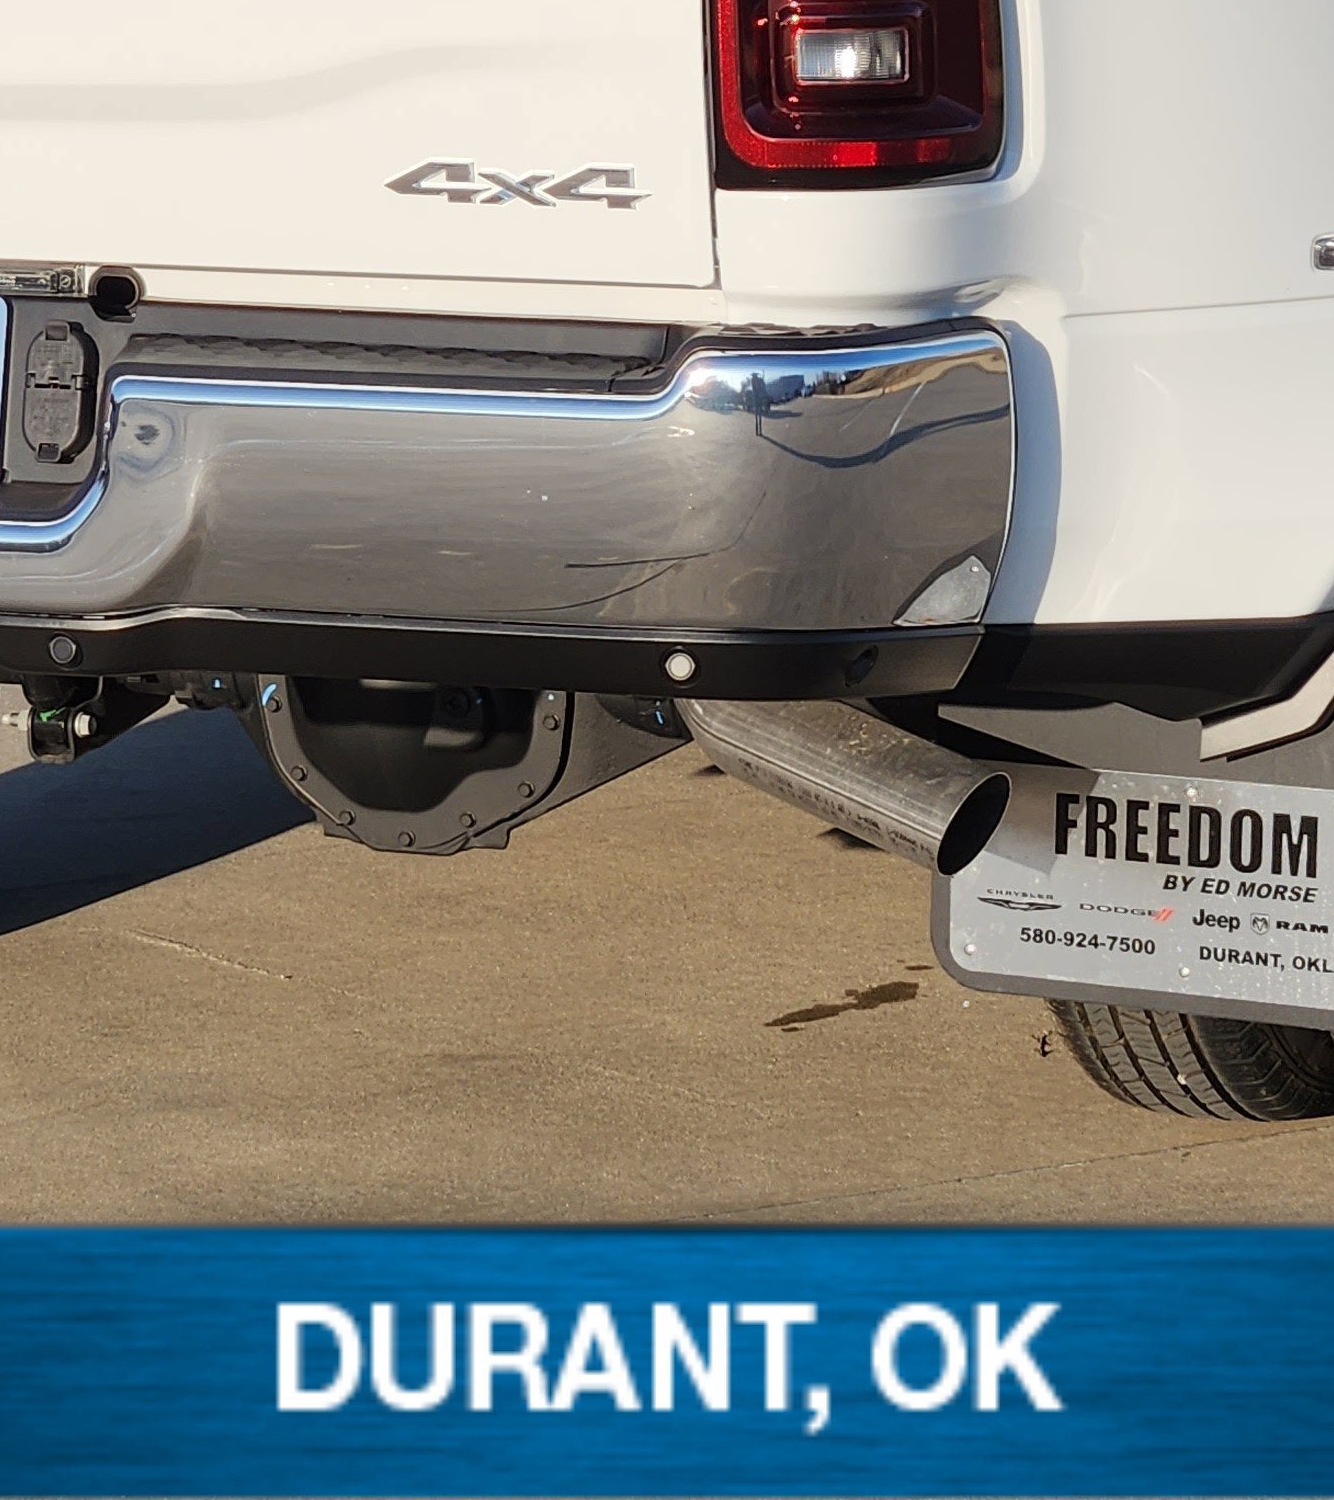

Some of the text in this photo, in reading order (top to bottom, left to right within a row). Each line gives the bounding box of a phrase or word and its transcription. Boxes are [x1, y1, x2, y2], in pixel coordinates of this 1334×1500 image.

[1054, 792, 1320, 879] FREEDOM
[986, 888, 1055, 900] CHRYSLER
[1192, 908, 1241, 933] Jeep
[1275, 920, 1329, 934] RAM
[1163, 874, 1320, 904] BY ED MORSE
[1019, 927, 1156, 955] 580-924-7500
[1199, 945, 1286, 972] DURANT,
